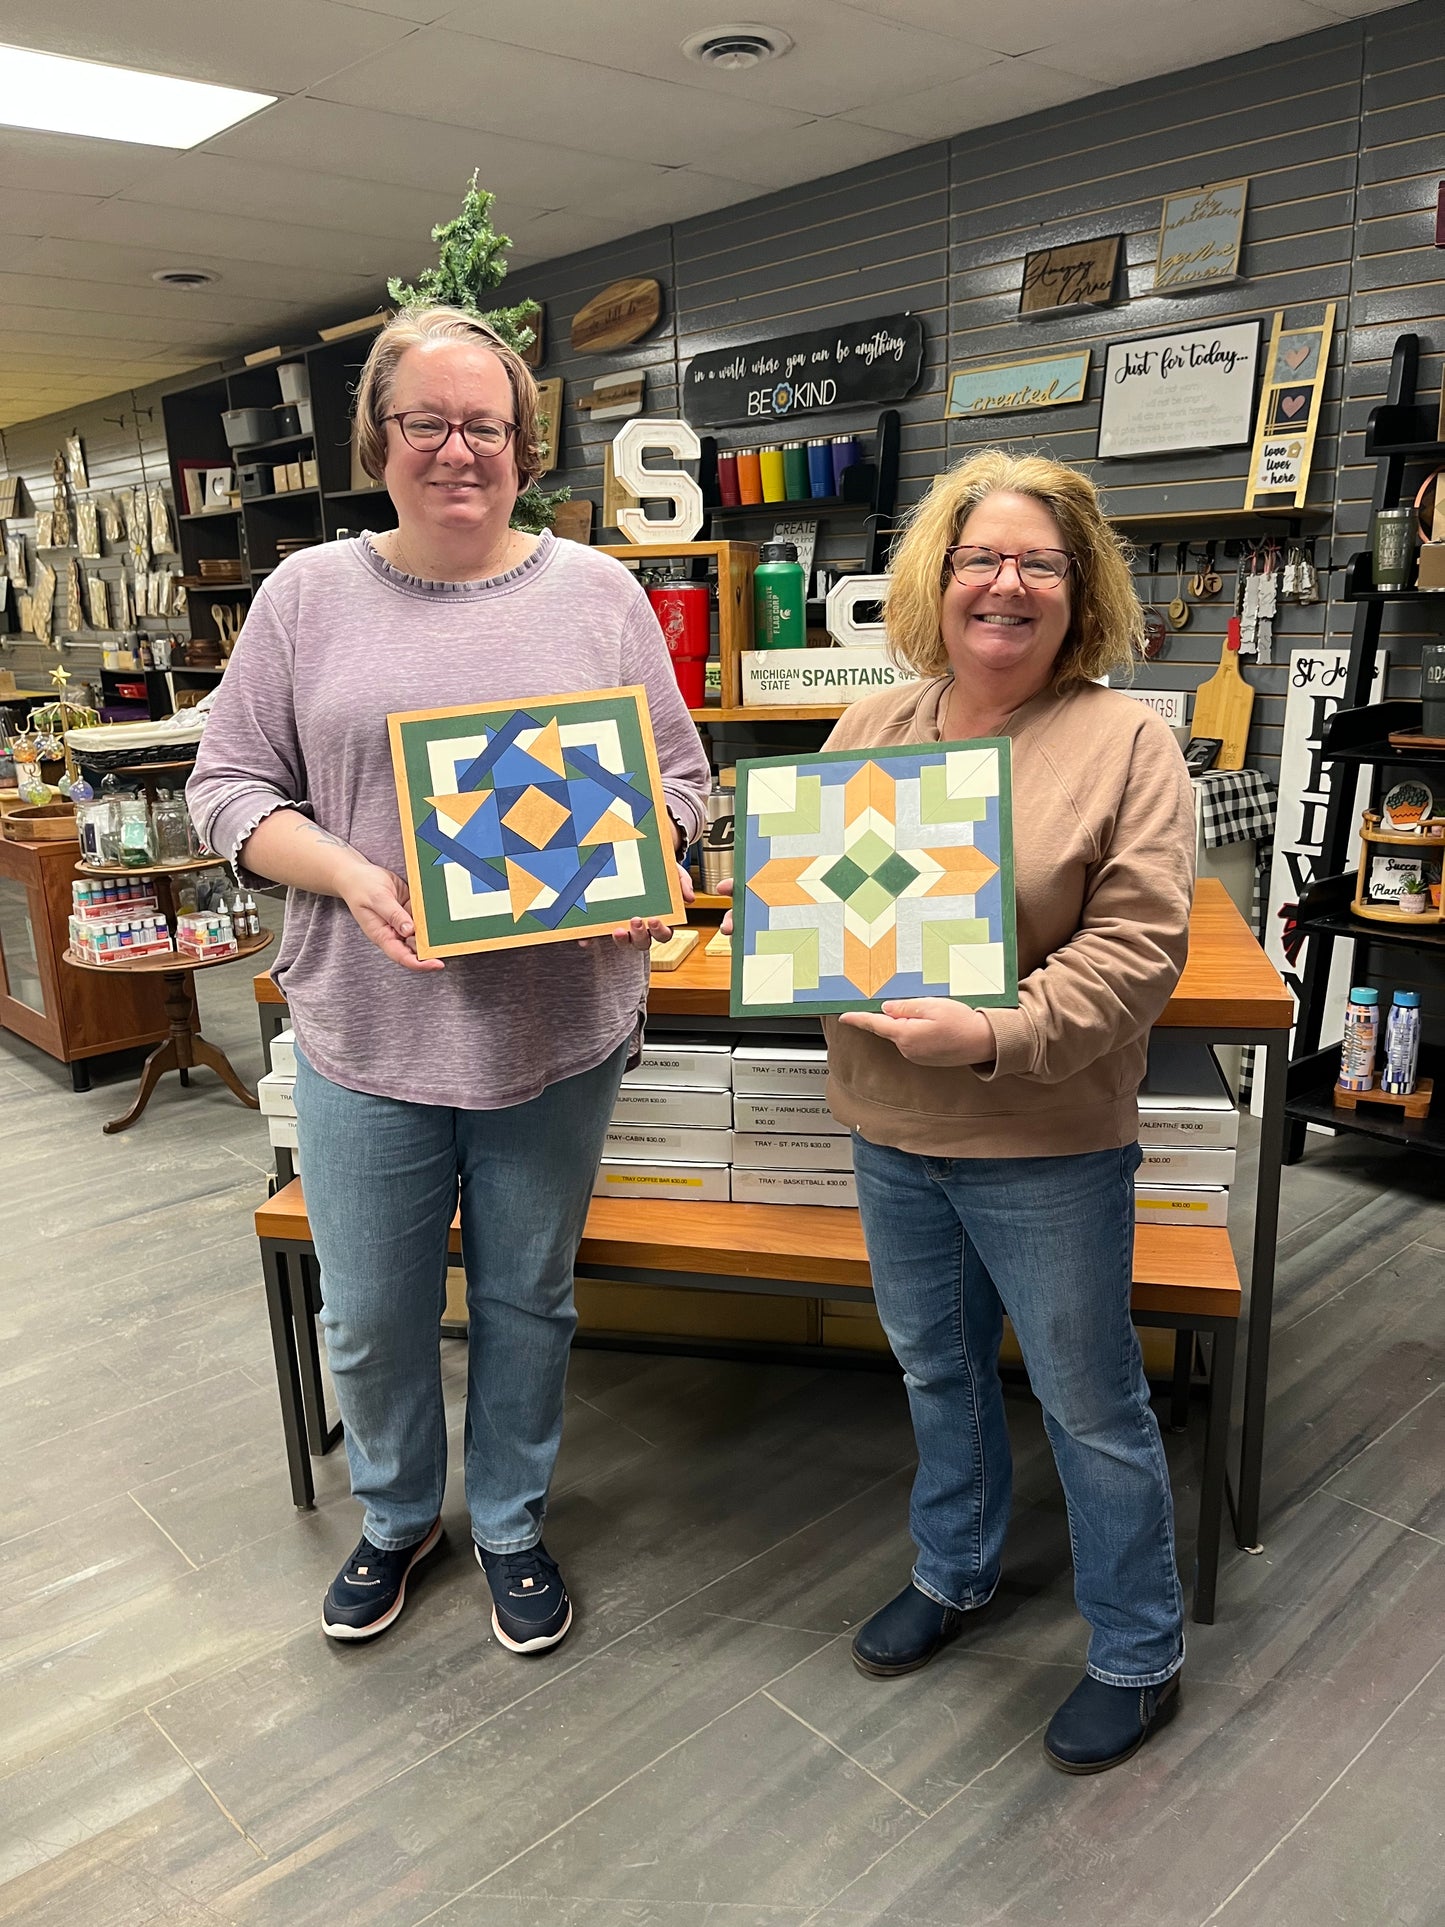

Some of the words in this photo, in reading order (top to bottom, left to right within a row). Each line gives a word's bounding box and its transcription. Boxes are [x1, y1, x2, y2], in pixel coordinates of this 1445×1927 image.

[694, 371, 705, 383] in
[708, 370, 716, 379] a
[719, 356, 747, 380] world
[751, 355, 780, 376] where
[785, 353, 806, 378] you
[812, 349, 829, 363] can
[836, 339, 850, 364] be
[855, 330, 906, 366] anything
[1114, 351, 1158, 384] Just
[1161, 347, 1184, 379] for
[1181, 340, 1248, 374] today...
[747, 388, 773, 416] BE
[794, 379, 837, 408] KIND
[962, 378, 1073, 411] created
[1264, 444, 1287, 457] love
[1266, 459, 1291, 471] lives
[1270, 472, 1296, 484] here
[775, 521, 816, 536] CREATE
[772, 595, 780, 614] CORP
[750, 669, 800, 680] MICHIGAN
[802, 667, 895, 687] SPARTANS
[1292, 658, 1324, 687] St
[760, 680, 790, 690] STATE
[1139, 1122, 1179, 1130] VALENTINE
[1180, 1123, 1204, 1131] $30.00
